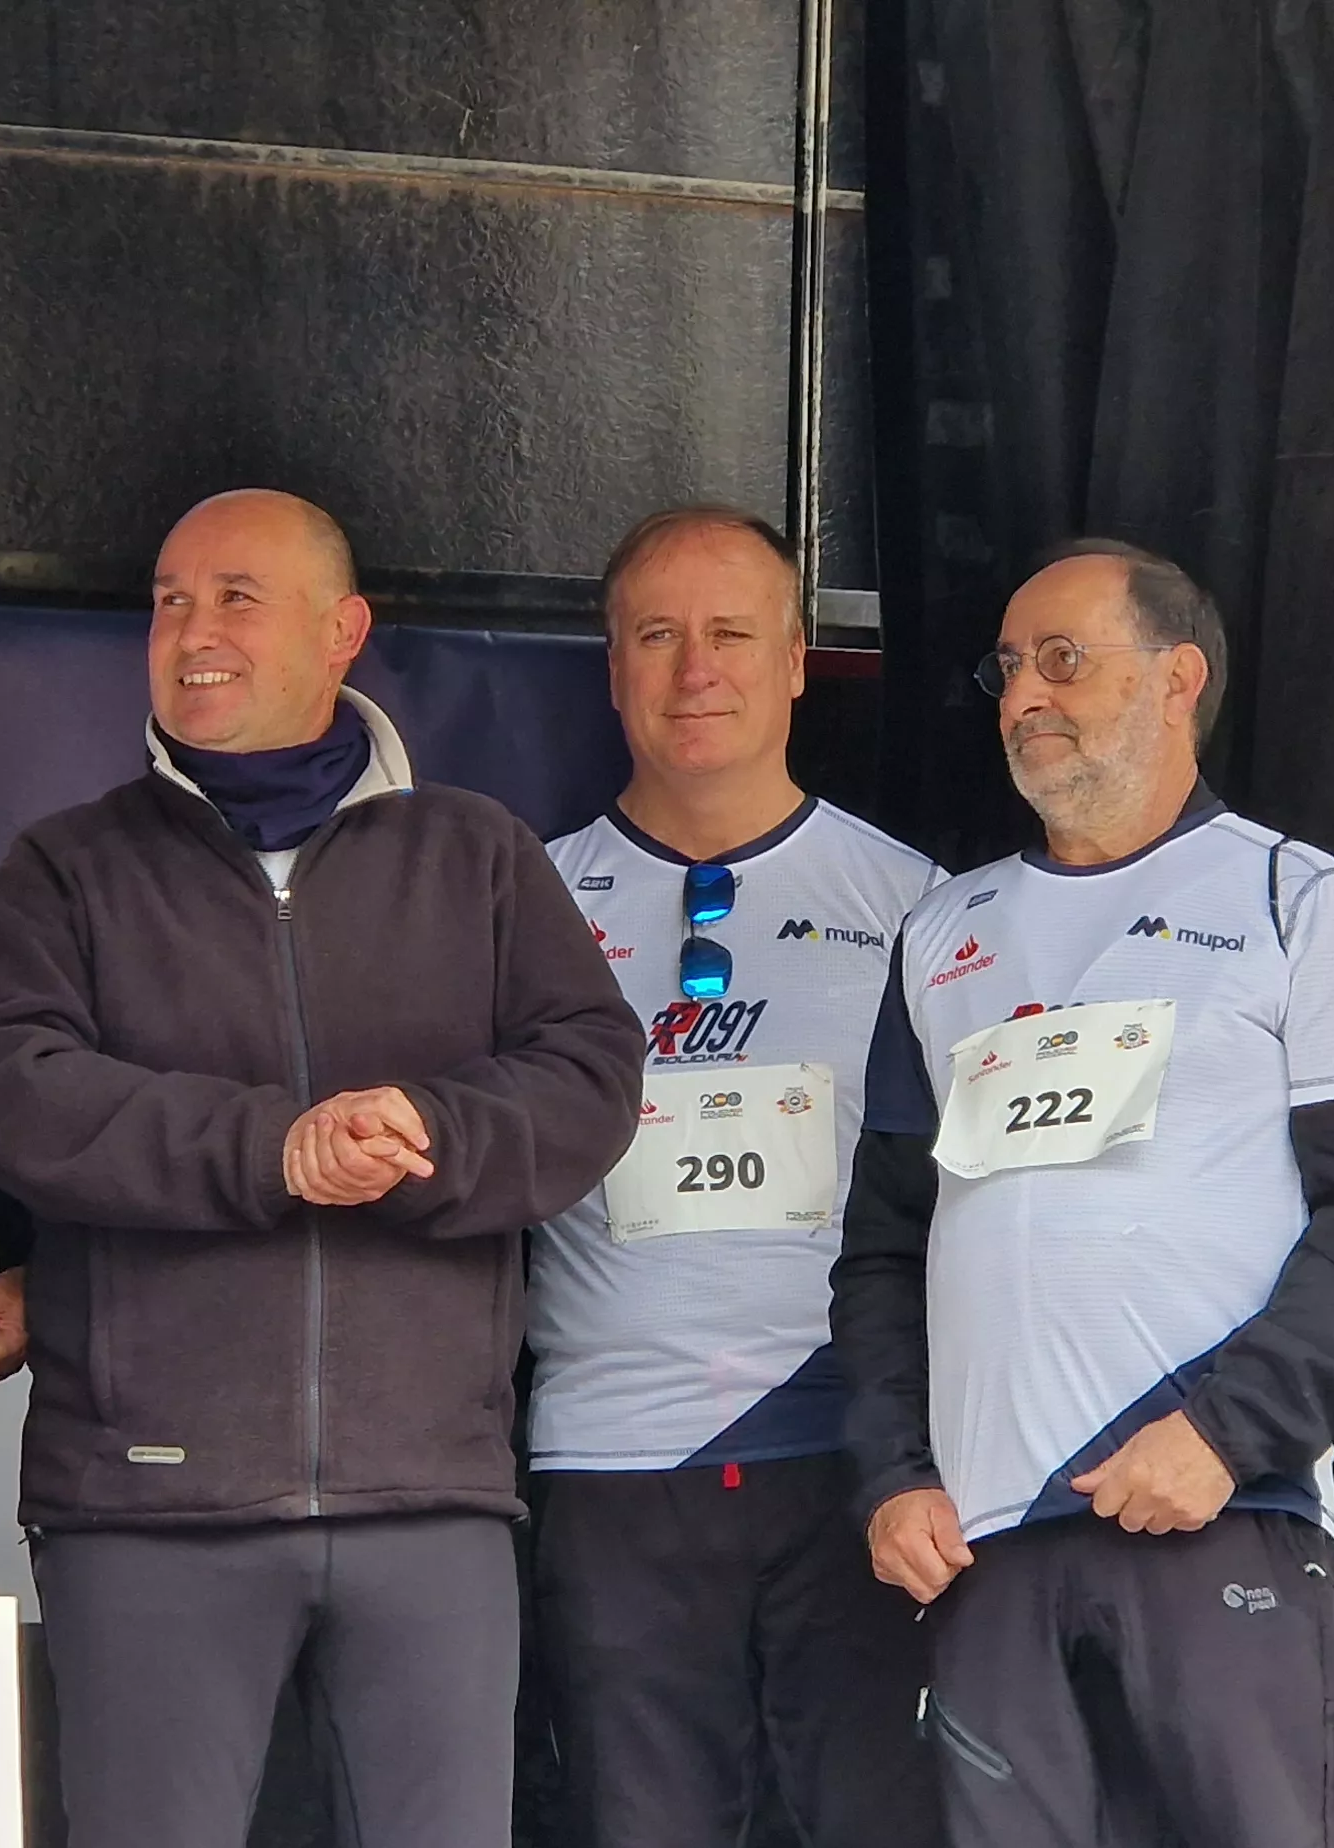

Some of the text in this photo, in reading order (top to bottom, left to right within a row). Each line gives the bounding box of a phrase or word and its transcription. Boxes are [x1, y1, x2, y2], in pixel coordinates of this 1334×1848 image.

[825, 926, 885, 949] mupol
[1176, 928, 1246, 952] mupol
[639, 1114, 675, 1126] tander
[1005, 1087, 1094, 1135] 222
[675, 1151, 765, 1193] 290
